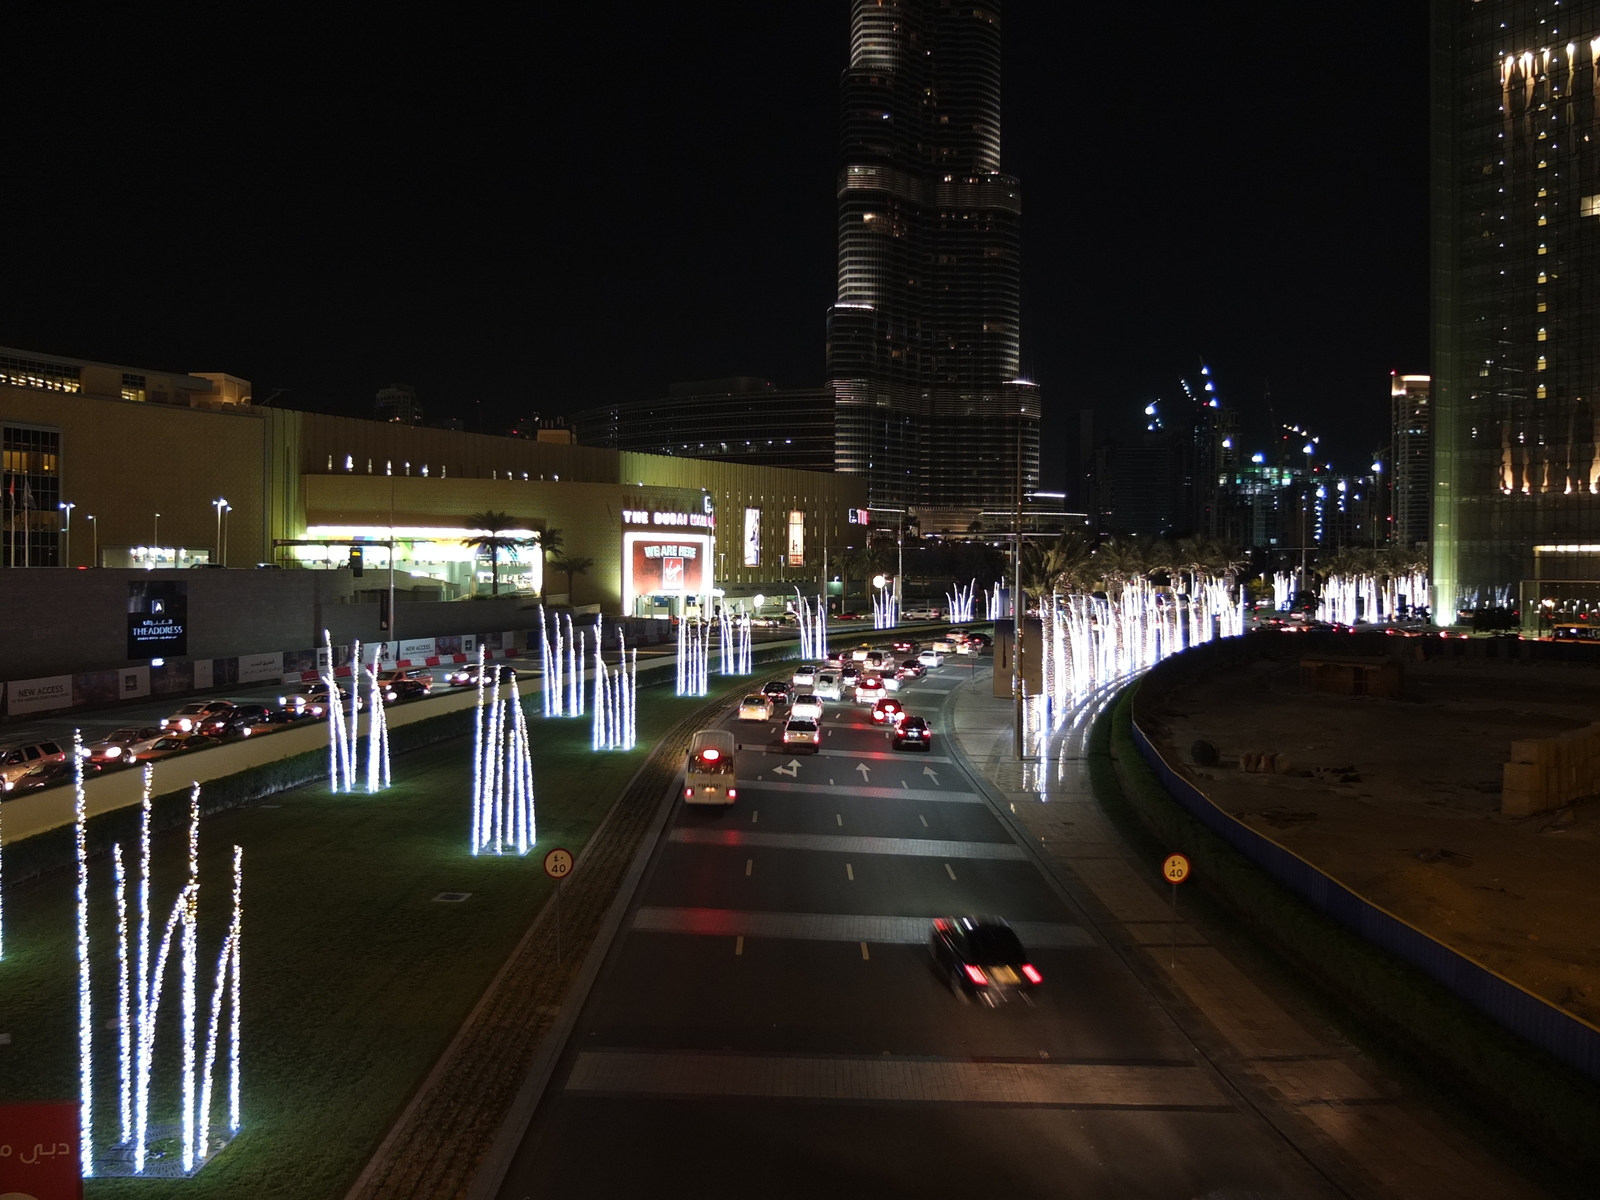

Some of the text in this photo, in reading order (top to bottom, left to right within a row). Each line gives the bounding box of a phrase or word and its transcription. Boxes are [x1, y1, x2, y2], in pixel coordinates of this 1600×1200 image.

[623, 511, 649, 524] THE
[654, 512, 687, 526] DUBAI
[644, 545, 697, 559] WE ARE HERE
[18, 685, 64, 697] NEW ACCESS
[551, 864, 566, 873] 40
[1169, 868, 1183, 878] 40
[20, 1143, 70, 1165] دبي
